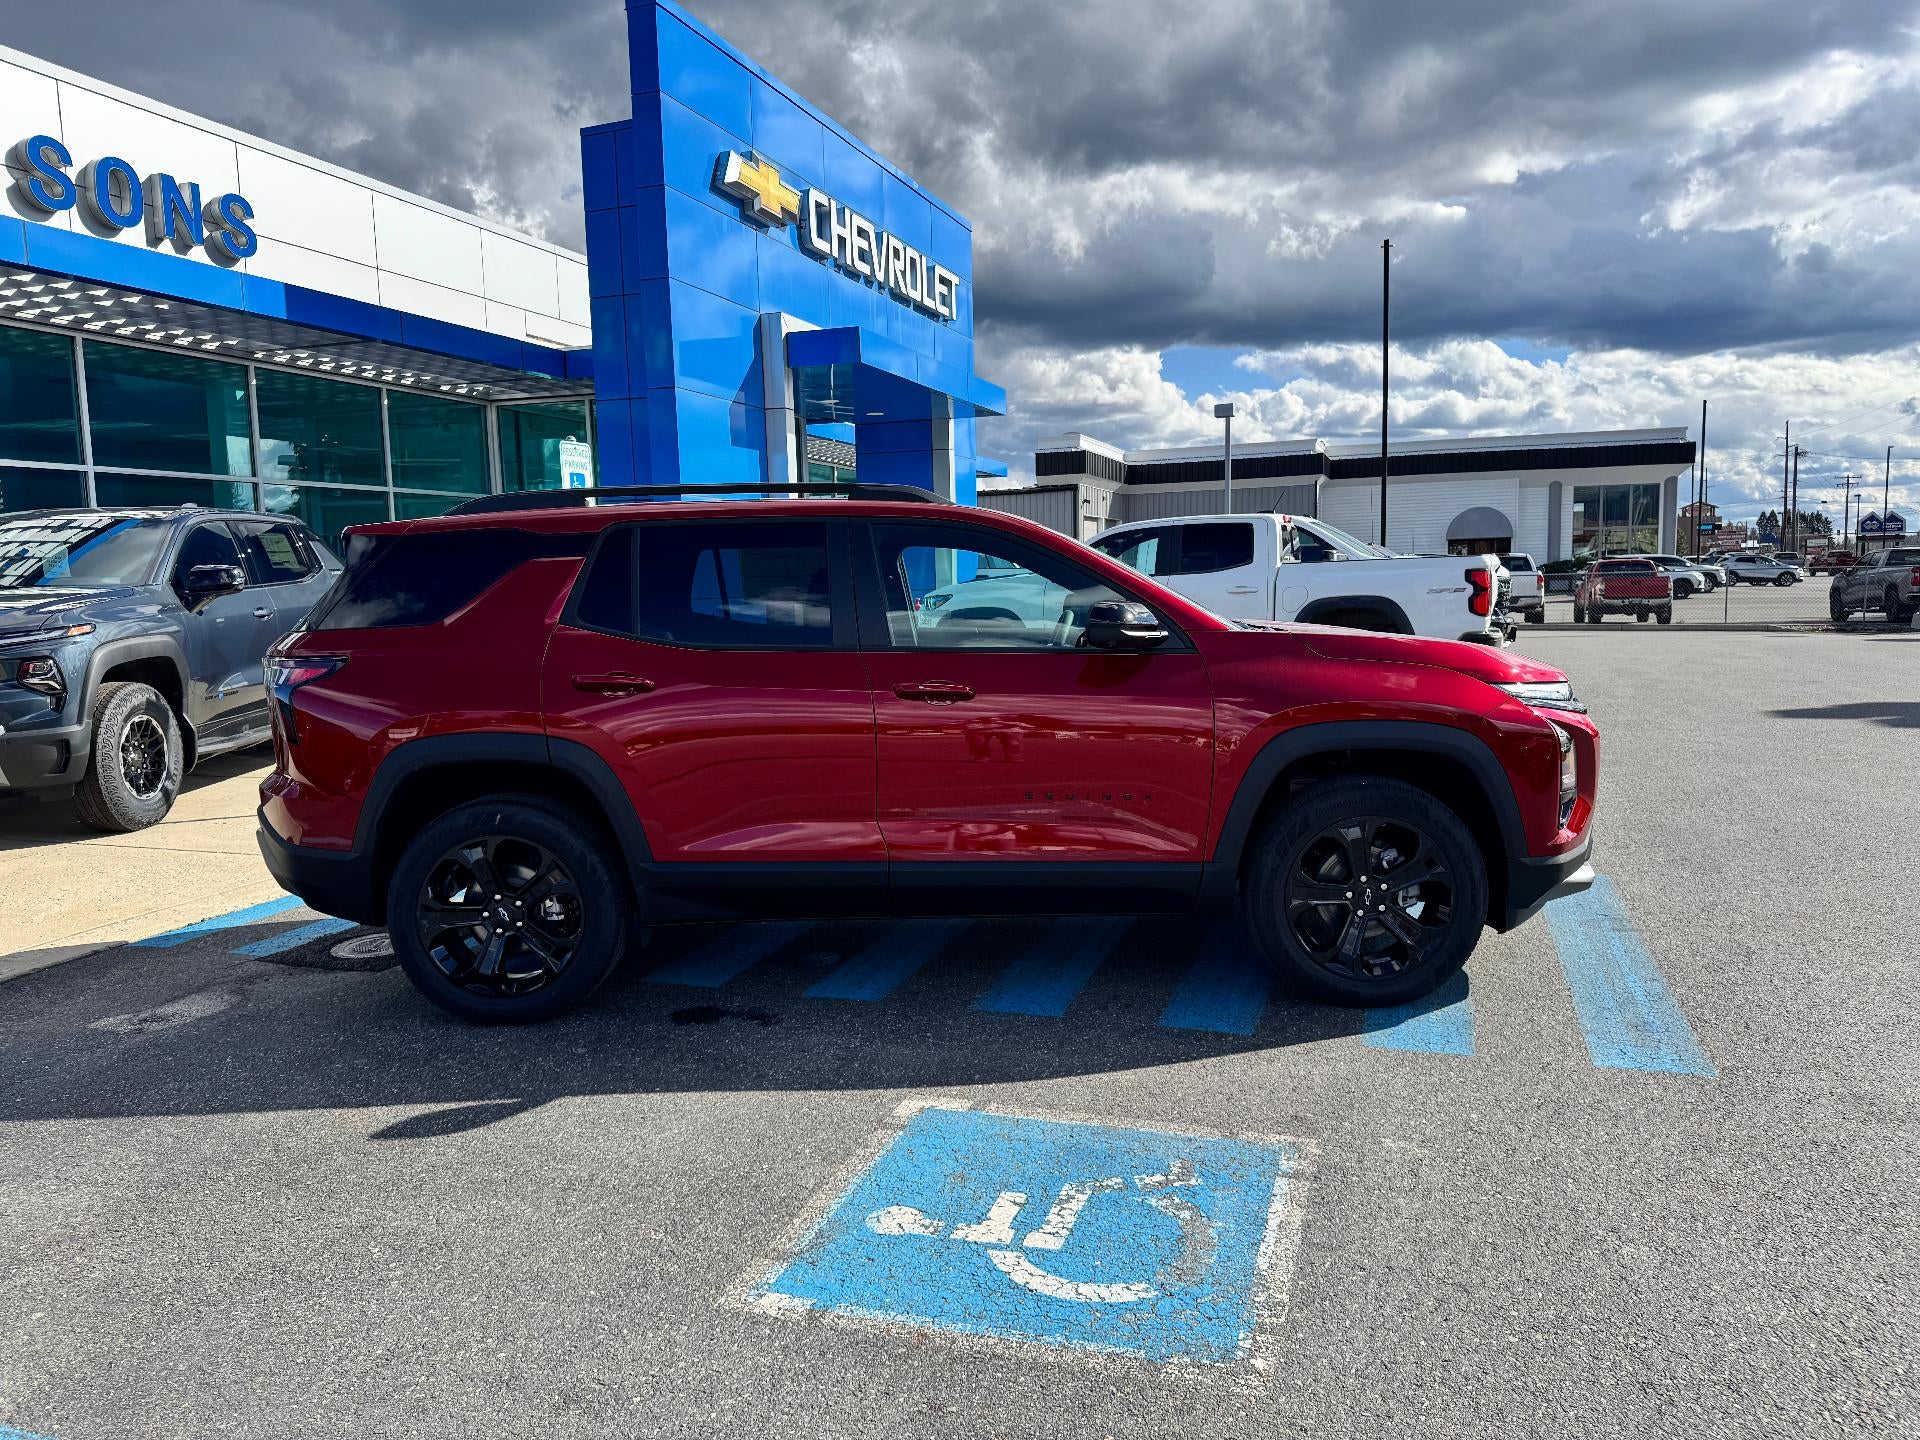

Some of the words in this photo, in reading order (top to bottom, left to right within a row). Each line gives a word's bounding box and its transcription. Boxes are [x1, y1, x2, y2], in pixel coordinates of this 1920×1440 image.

[21, 134, 258, 260] SONS
[808, 187, 960, 321] CHEVROLET
[562, 446, 588, 459] RESERVED
[564, 459, 588, 471] PARKING
[1024, 791, 1153, 801] EQUINOX
